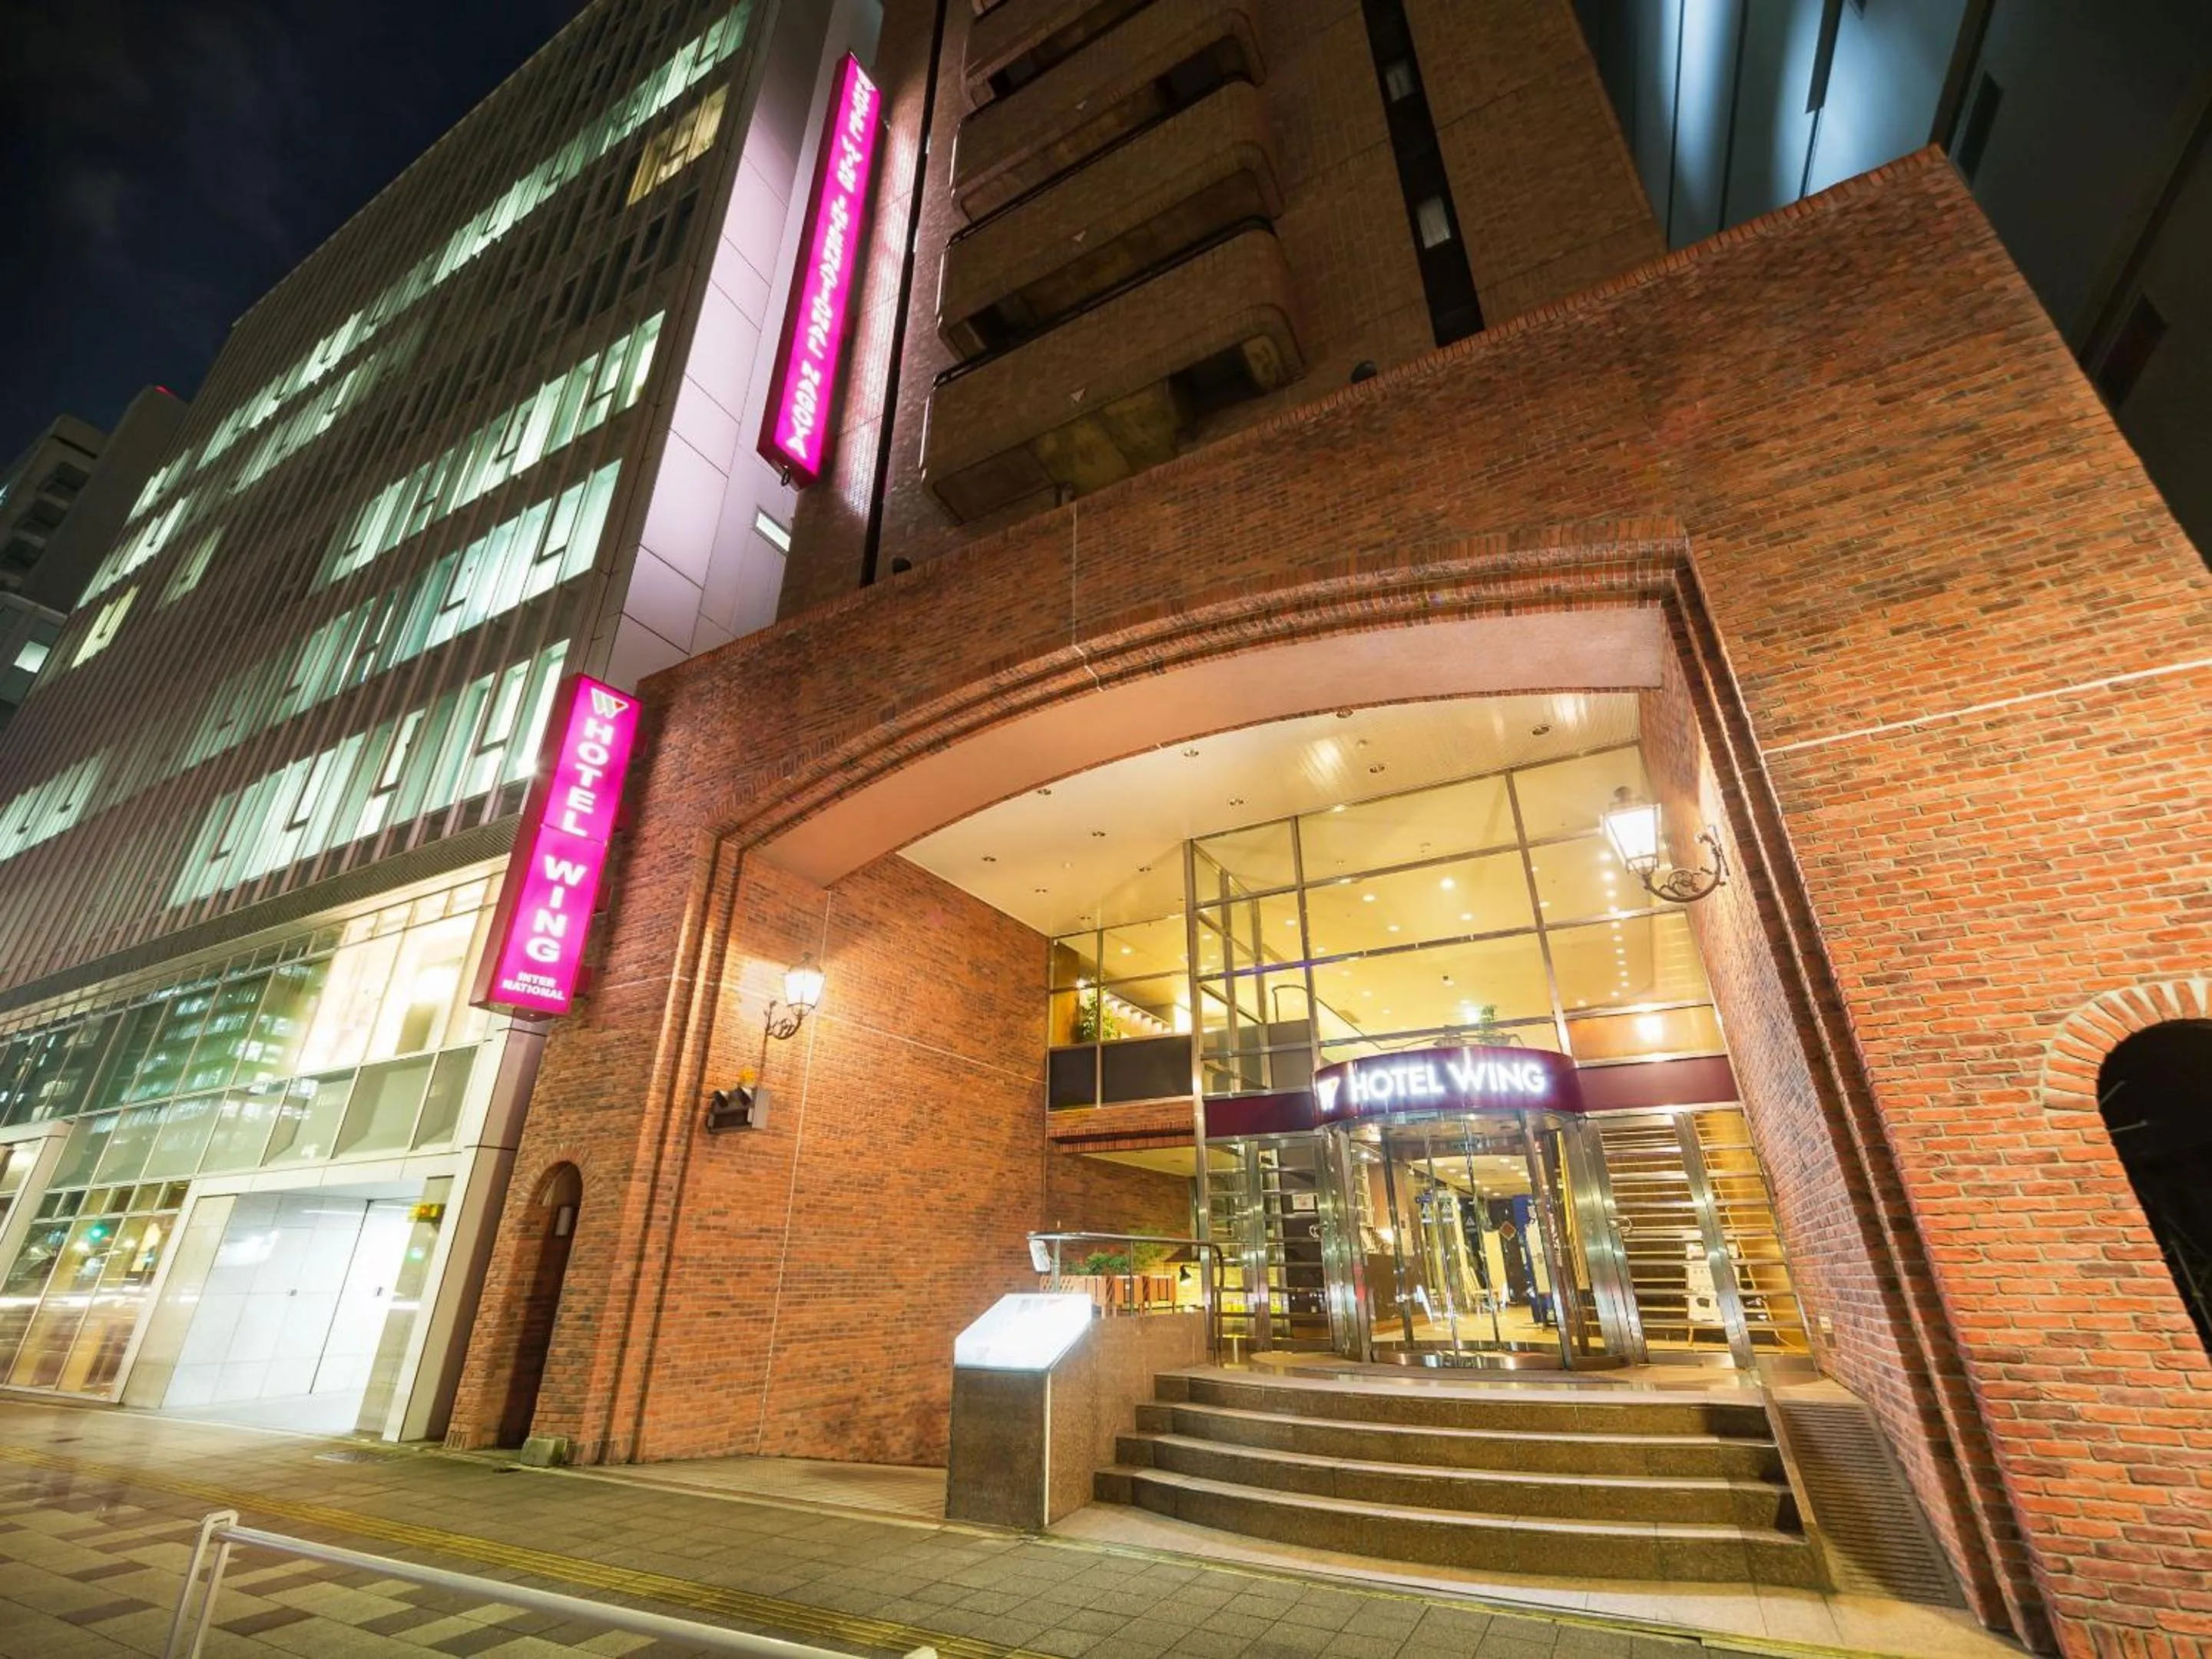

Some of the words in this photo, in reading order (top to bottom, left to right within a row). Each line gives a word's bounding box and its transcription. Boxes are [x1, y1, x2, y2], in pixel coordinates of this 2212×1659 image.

[786, 359, 821, 459] NAGOYA
[561, 717, 614, 837] HOTEL
[525, 854, 588, 963] WING
[502, 979, 565, 1001] NATIONAL
[518, 971, 556, 988] INTER
[1349, 1063, 1444, 1102] HOTEL
[1446, 1057, 1547, 1094] WING
